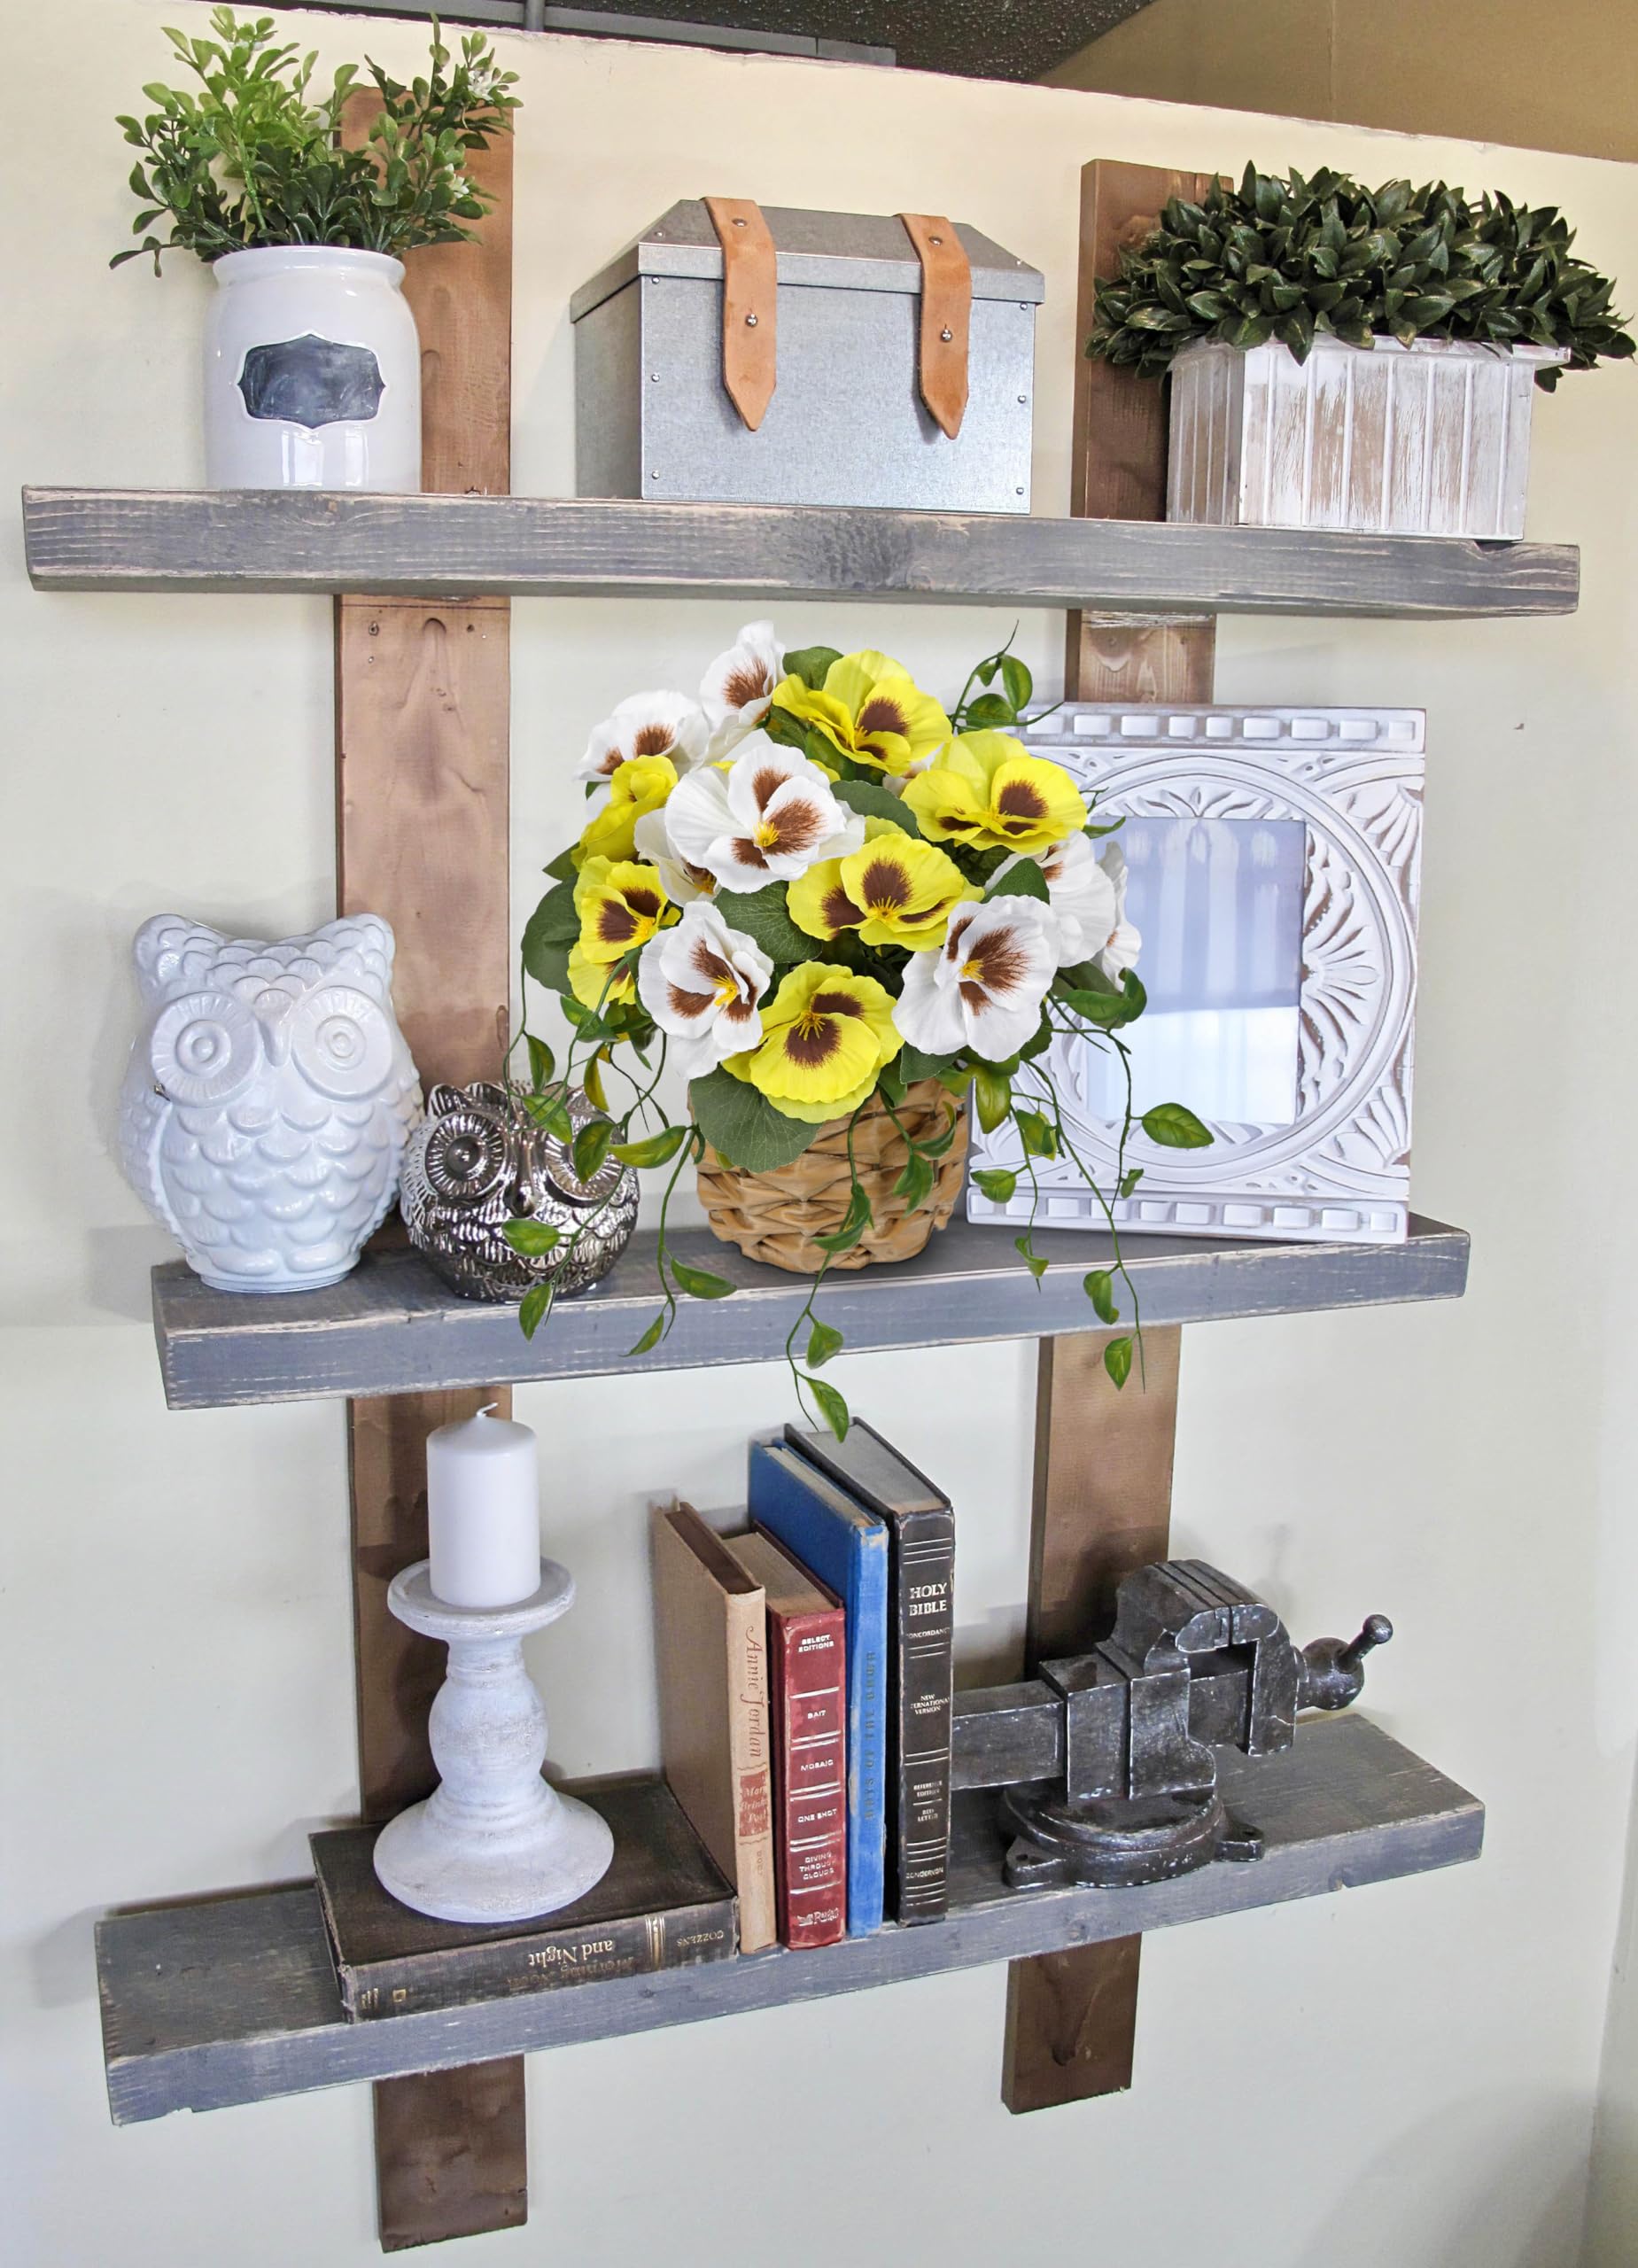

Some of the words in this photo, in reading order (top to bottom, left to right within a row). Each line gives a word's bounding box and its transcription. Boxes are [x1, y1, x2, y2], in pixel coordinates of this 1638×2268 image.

[909, 1582, 948, 1599] HOLY
[909, 1599, 948, 1617] BIBLE
[798, 1641, 835, 1653] EDITIONS
[801, 1634, 831, 1645] SELECT
[745, 1625, 764, 1689] Annie
[807, 1709, 827, 1720] BAIT
[914, 1705, 941, 1715] VERSION
[740, 1690, 766, 1758] Jordan
[800, 1759, 834, 1772] MOSAIC
[797, 1814, 815, 1823] ONE
[817, 1808, 837, 1819] SHOT
[803, 1868, 835, 1880] CLOUDS
[676, 1930, 725, 1947] COZZENS
[527, 1946, 578, 1969] Night
[581, 1939, 613, 1961] and
